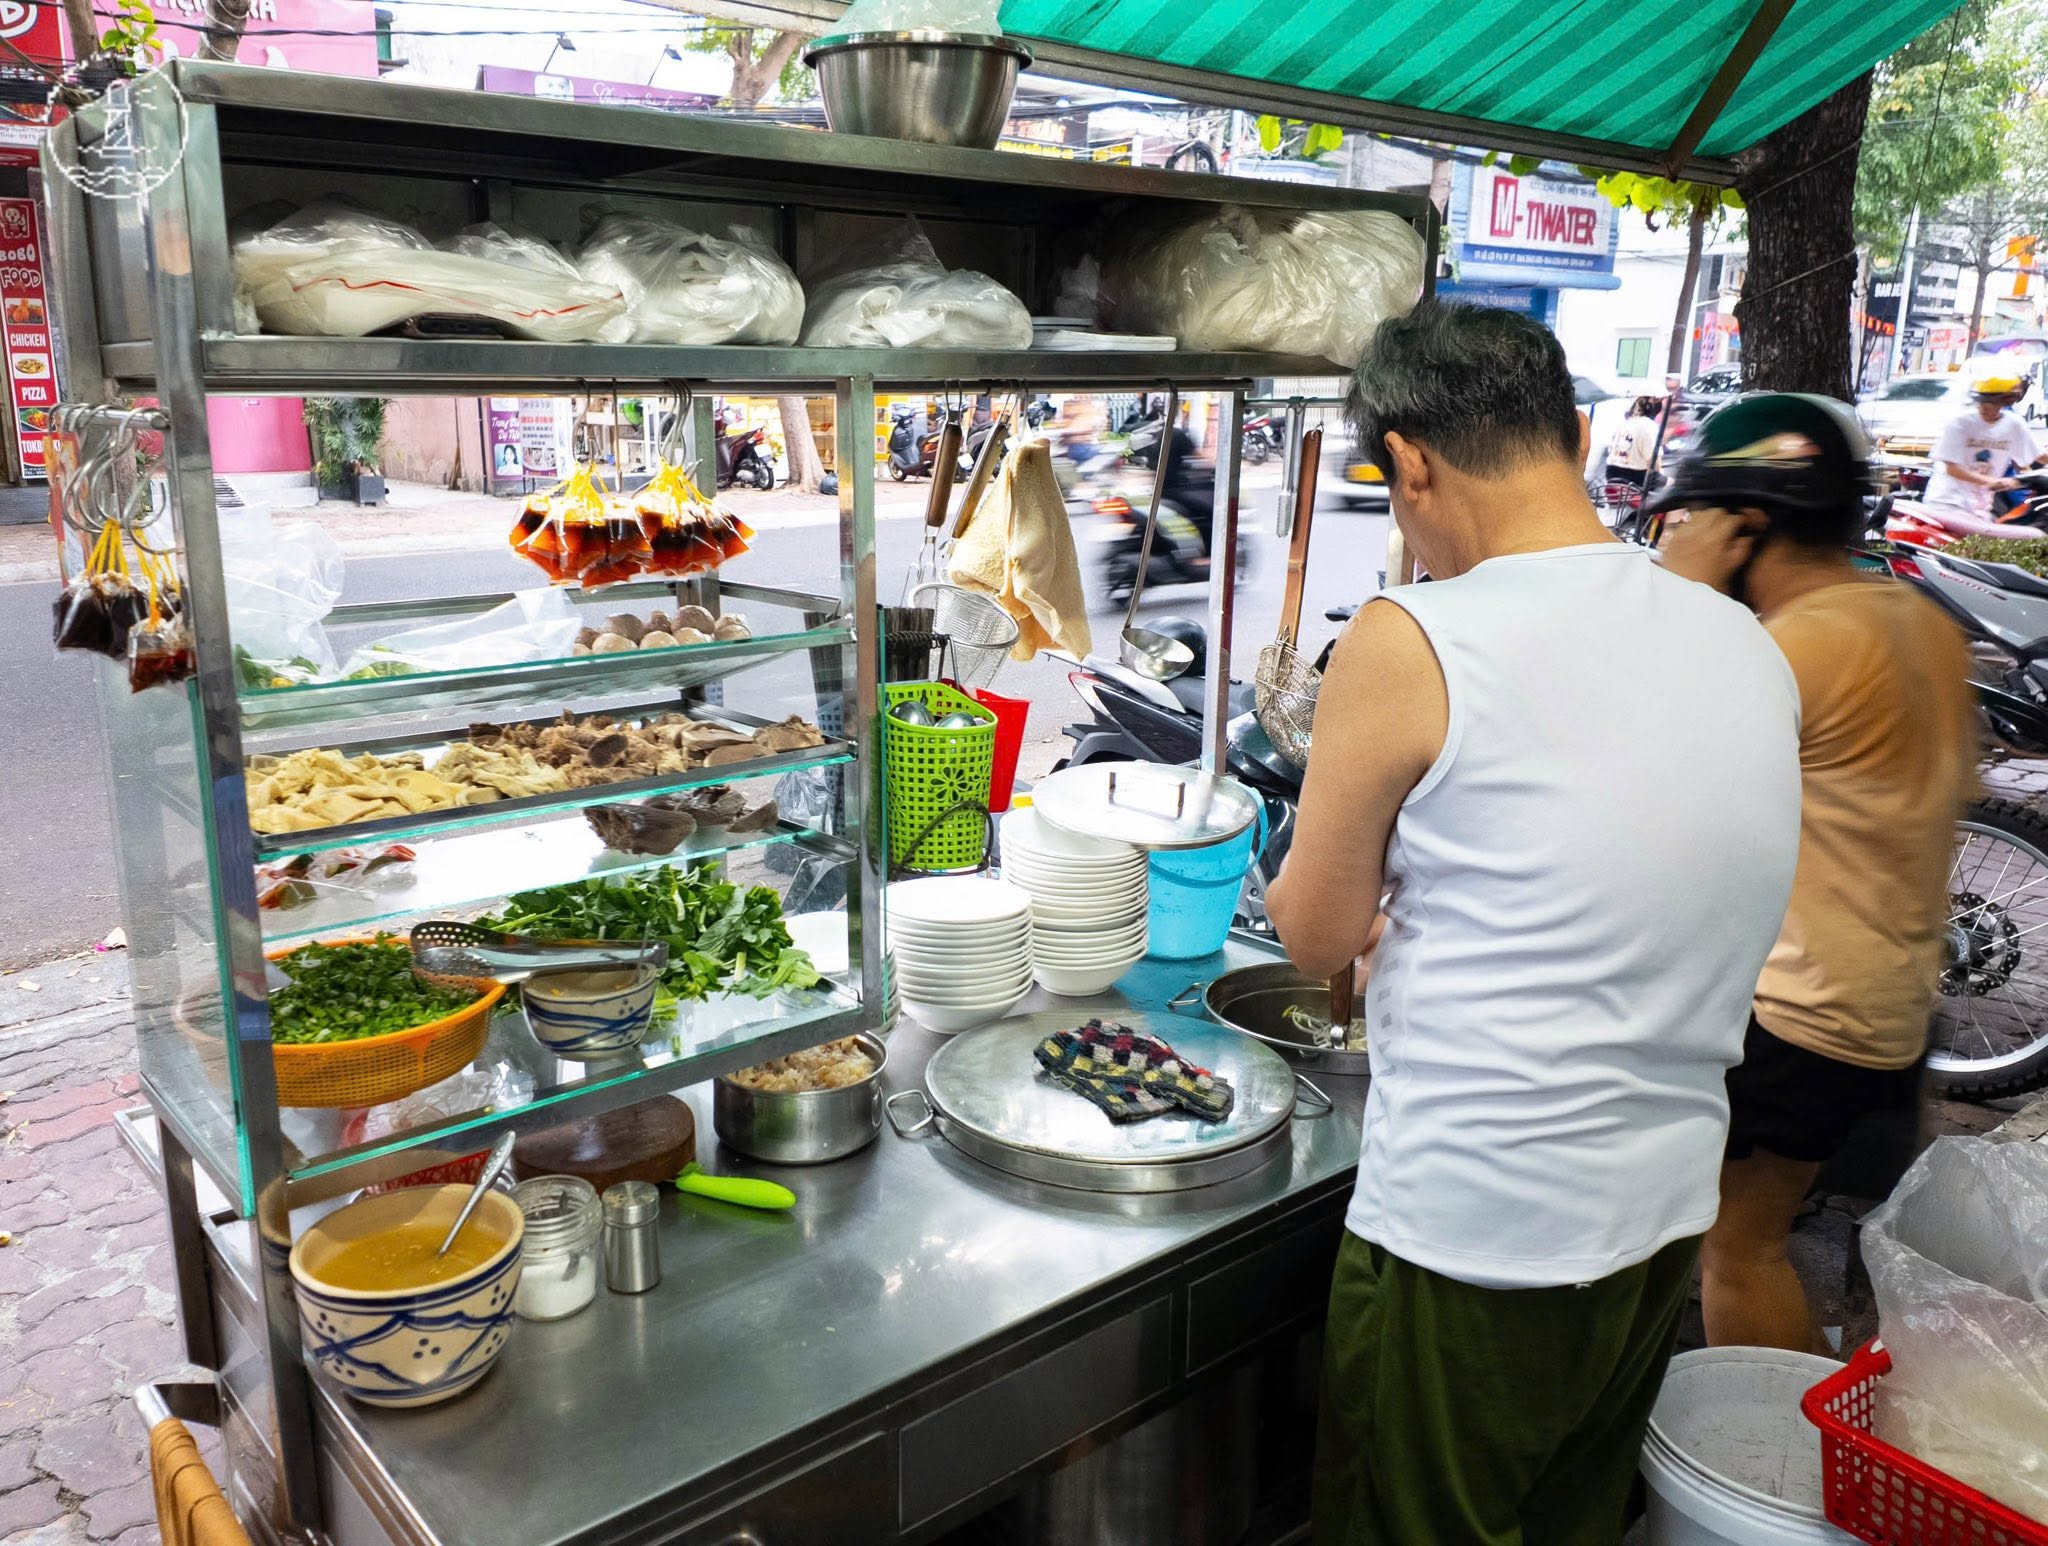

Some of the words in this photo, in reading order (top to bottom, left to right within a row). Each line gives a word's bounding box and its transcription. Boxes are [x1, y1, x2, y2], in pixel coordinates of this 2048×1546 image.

[0, 243, 35, 262] BOBO
[0, 267, 41, 288] FOOD
[10, 333, 46, 347] CHICKEN
[21, 387, 47, 401] PIZZA
[21, 439, 61, 454] TOKBKI
